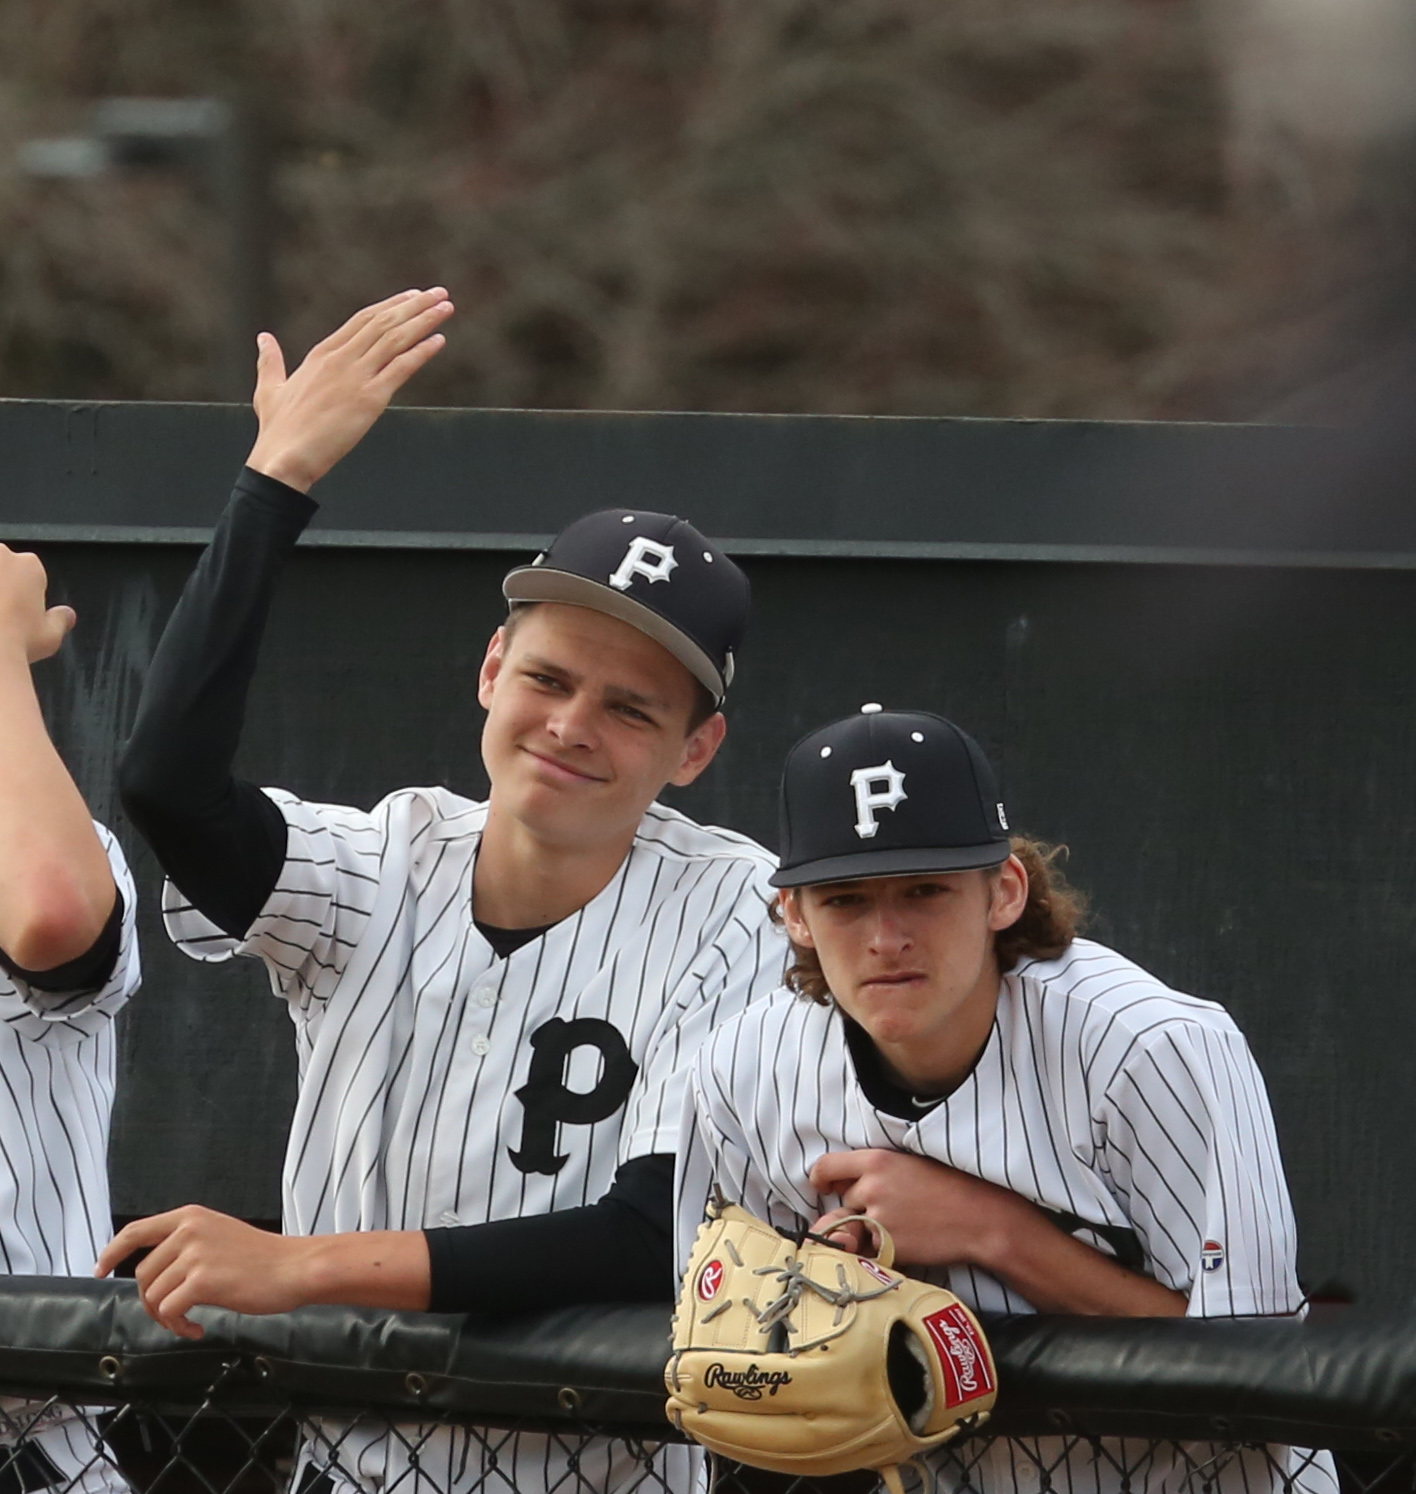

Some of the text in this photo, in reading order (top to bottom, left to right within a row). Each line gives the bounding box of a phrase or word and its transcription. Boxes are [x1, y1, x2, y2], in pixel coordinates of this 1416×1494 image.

[609, 536, 679, 591] P
[850, 760, 908, 838] P
[506, 1017, 639, 1176] P
[704, 1362, 793, 1397] Rawlings
[939, 1319, 978, 1391] Rawlings
